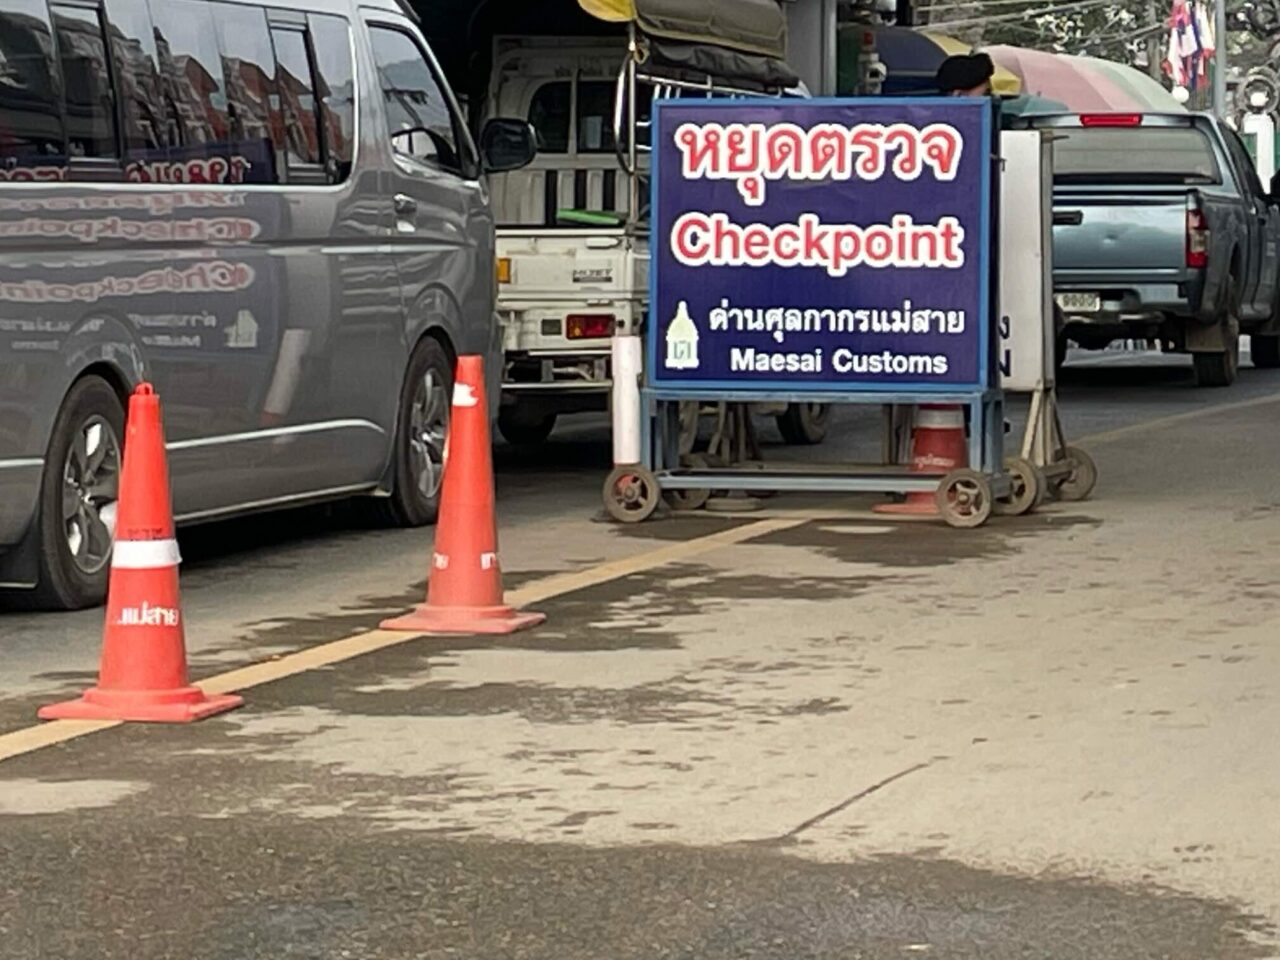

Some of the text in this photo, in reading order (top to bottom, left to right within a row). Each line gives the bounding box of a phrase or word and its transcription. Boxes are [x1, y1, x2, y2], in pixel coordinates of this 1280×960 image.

[675, 123, 963, 204] หยุดตรวจ
[672, 213, 965, 276] Checkpoint
[709, 297, 966, 342] ด่านศุลกากรแม่สาย
[731, 348, 948, 373] Maesai Customs
